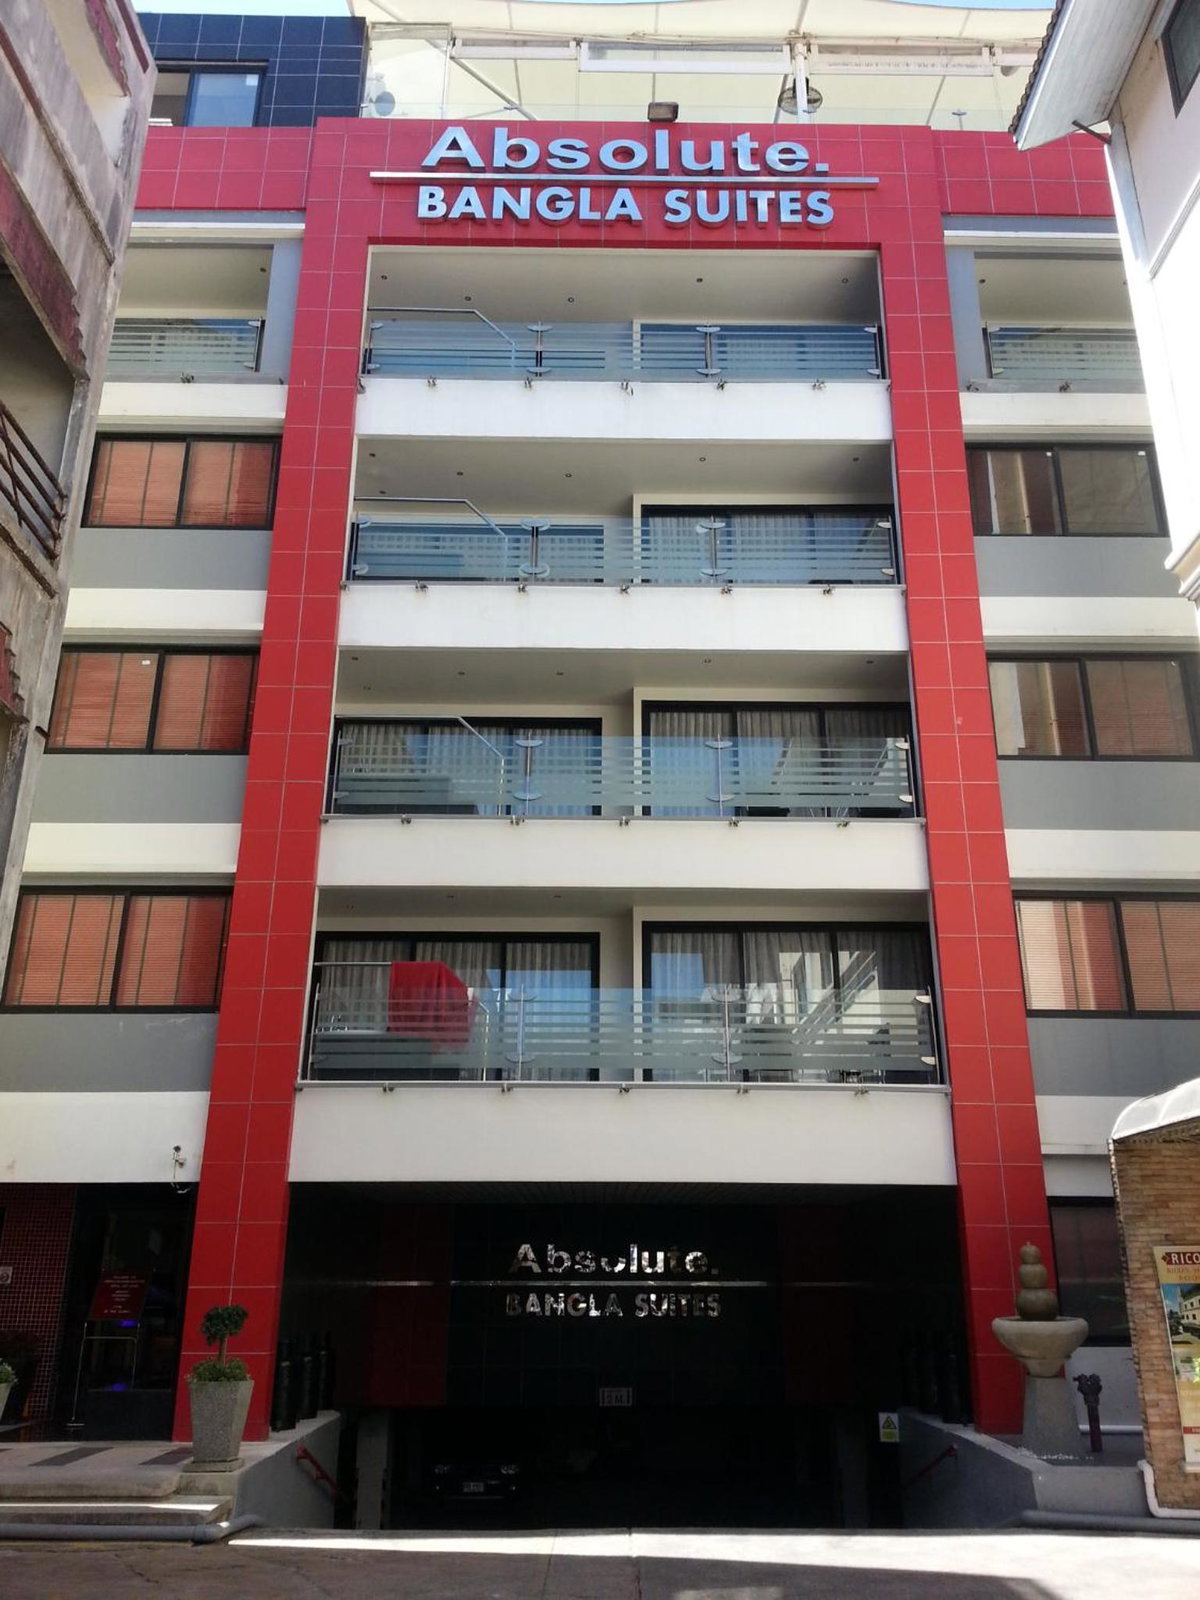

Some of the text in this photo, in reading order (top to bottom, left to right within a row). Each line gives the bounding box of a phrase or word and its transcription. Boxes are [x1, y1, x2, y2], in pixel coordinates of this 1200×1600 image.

[421, 126, 830, 173] Absolute.
[417, 185, 835, 228] BANGLA SUITES
[506, 1293, 721, 1317] BANGLA SUITES
